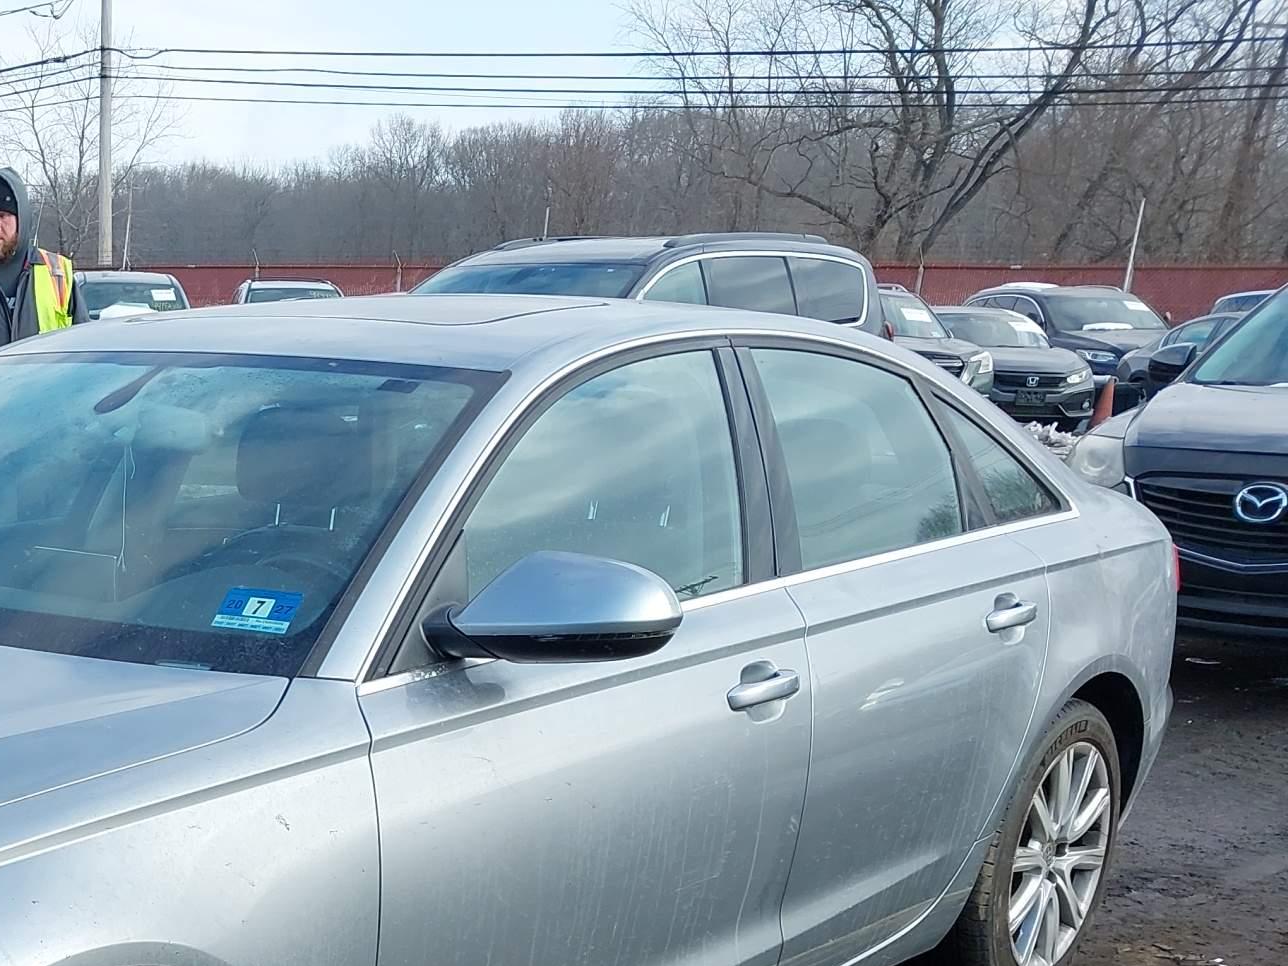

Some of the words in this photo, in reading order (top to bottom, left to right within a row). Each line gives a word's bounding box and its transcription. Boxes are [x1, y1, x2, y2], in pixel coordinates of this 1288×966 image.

[226, 599, 244, 609] 20
[252, 600, 266, 615] 7
[274, 605, 296, 615] 27
